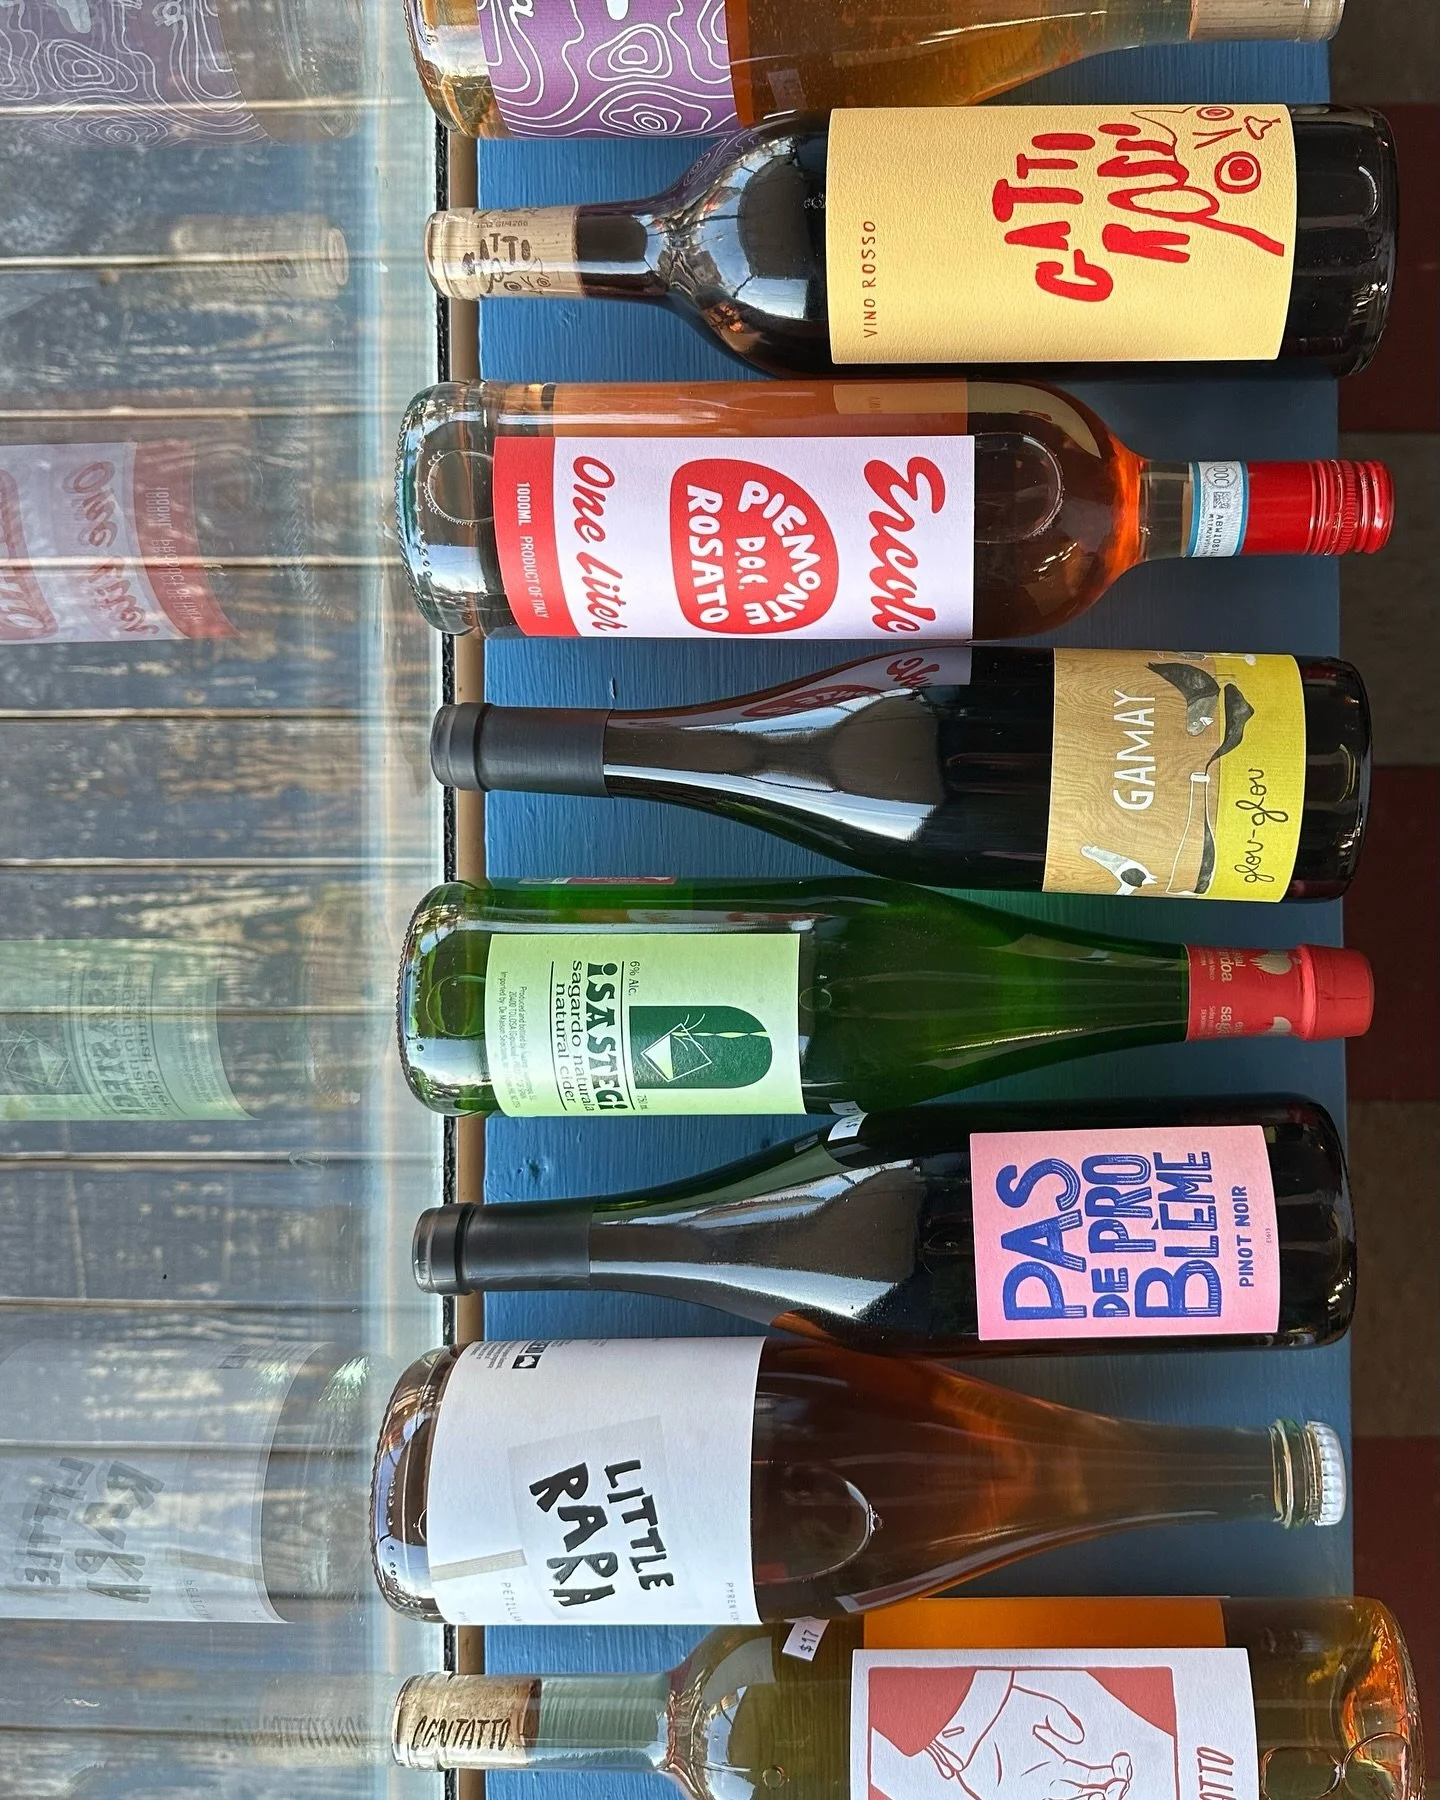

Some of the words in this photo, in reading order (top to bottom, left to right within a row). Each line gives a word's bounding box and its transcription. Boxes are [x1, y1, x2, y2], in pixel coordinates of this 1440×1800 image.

[992, 133, 1113, 302] GATTO
[1097, 124, 1220, 263] ROSSO
[861, 220, 877, 288] ROSSO
[861, 298, 878, 337] VINO
[517, 482, 531, 525] 1000ML
[573, 456, 615, 543] One
[520, 536, 536, 584] PRODUCT
[687, 484, 729, 624] ROSATO
[735, 536, 768, 590] D.O.C.
[737, 480, 822, 625] PIEMONTE
[864, 456, 946, 633] Ercole
[528, 586, 542, 597] OF
[531, 599, 549, 618] ITALY
[576, 552, 628, 631] Liter
[1112, 689, 1156, 810] GAMAY
[498, 972, 508, 996] Imported
[628, 979, 639, 996] Alc.
[629, 961, 640, 976] 6%
[499, 1006, 507, 1014] De
[509, 1008, 517, 1029] TOLOSA
[518, 986, 527, 1012] Produced
[519, 1013, 527, 1023] and
[555, 983, 569, 1058] natural
[568, 961, 583, 1047] sagardo
[499, 1015, 507, 1034] Maison
[519, 1024, 528, 1042] bottled
[559, 1066, 577, 1103] cider
[573, 1055, 595, 1111] naturala
[1081, 1153, 1155, 1253] PRO
[1231, 1186, 1251, 1227] NOIR
[996, 1158, 1087, 1320] PAS
[1135, 1151, 1222, 1318] BLÈME
[1236, 1235, 1254, 1287] PINOT
[1091, 1268, 1130, 1317] DE
[529, 1462, 619, 1608] RARA
[604, 1460, 675, 1591] LITTLE
[725, 1582, 736, 1609] PYREN
[799, 1629, 819, 1652] $17
